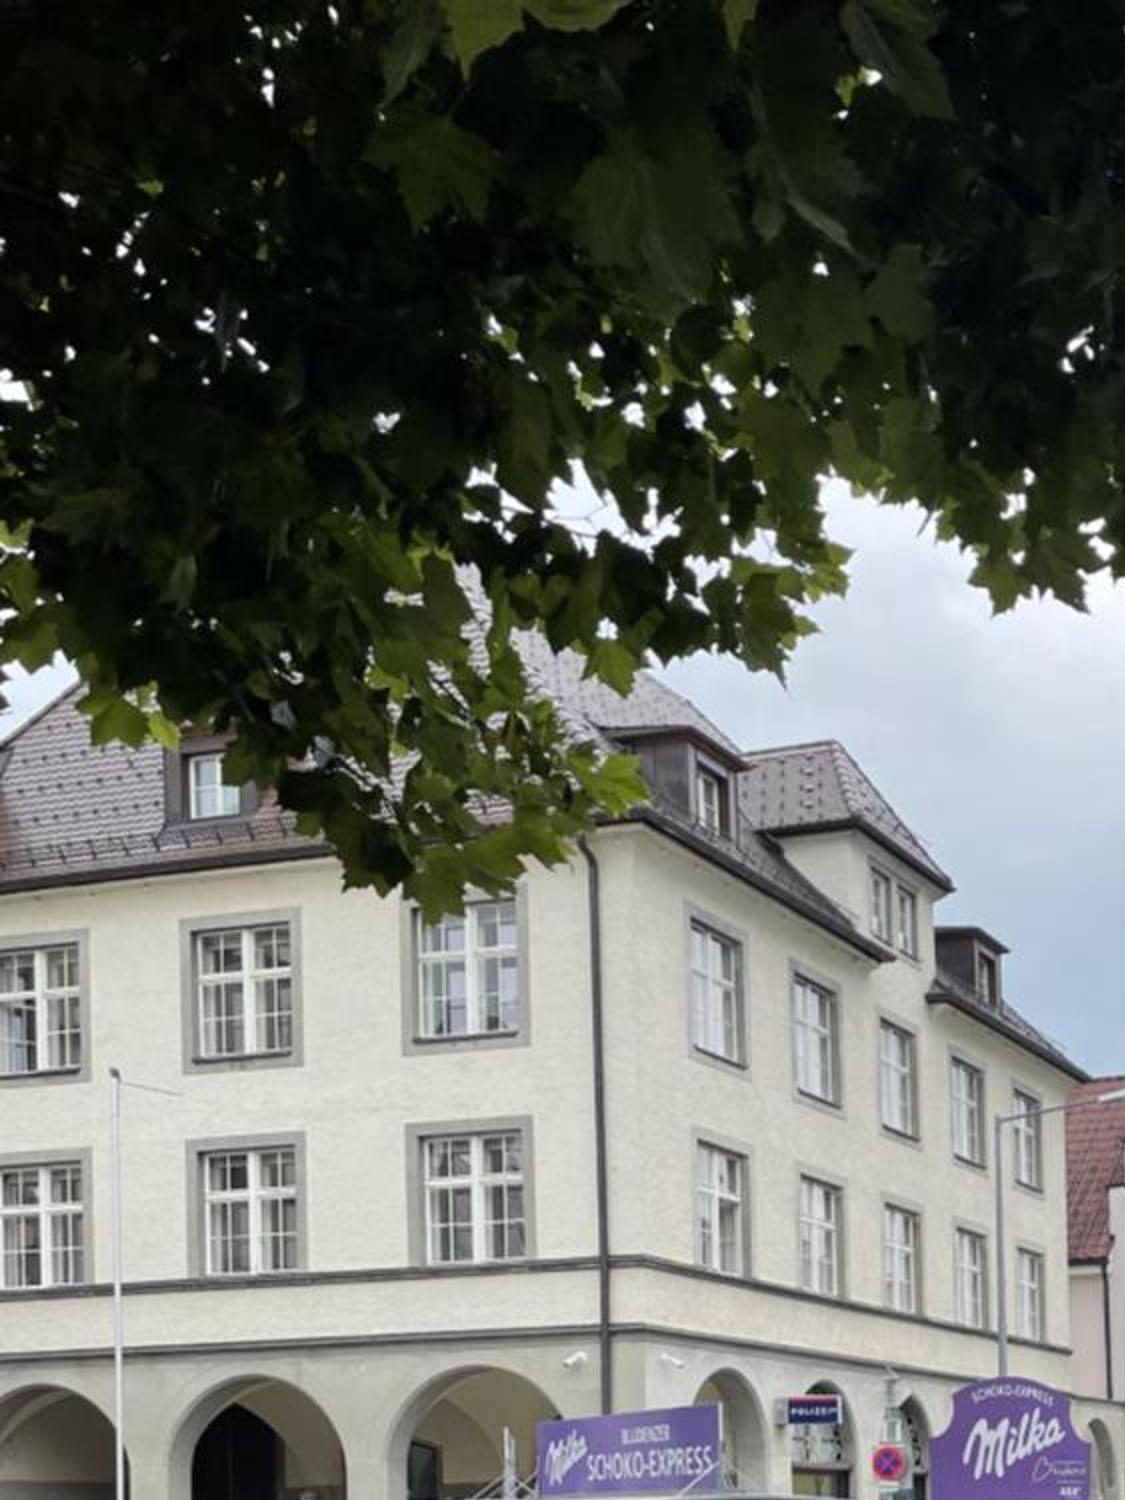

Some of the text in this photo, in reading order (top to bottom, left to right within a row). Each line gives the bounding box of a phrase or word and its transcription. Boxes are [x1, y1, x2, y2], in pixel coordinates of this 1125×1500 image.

[545, 1429, 588, 1486] Milka
[585, 1445, 713, 1481] SCHOKO-EXPRESS
[962, 1407, 1066, 1480] Milka
